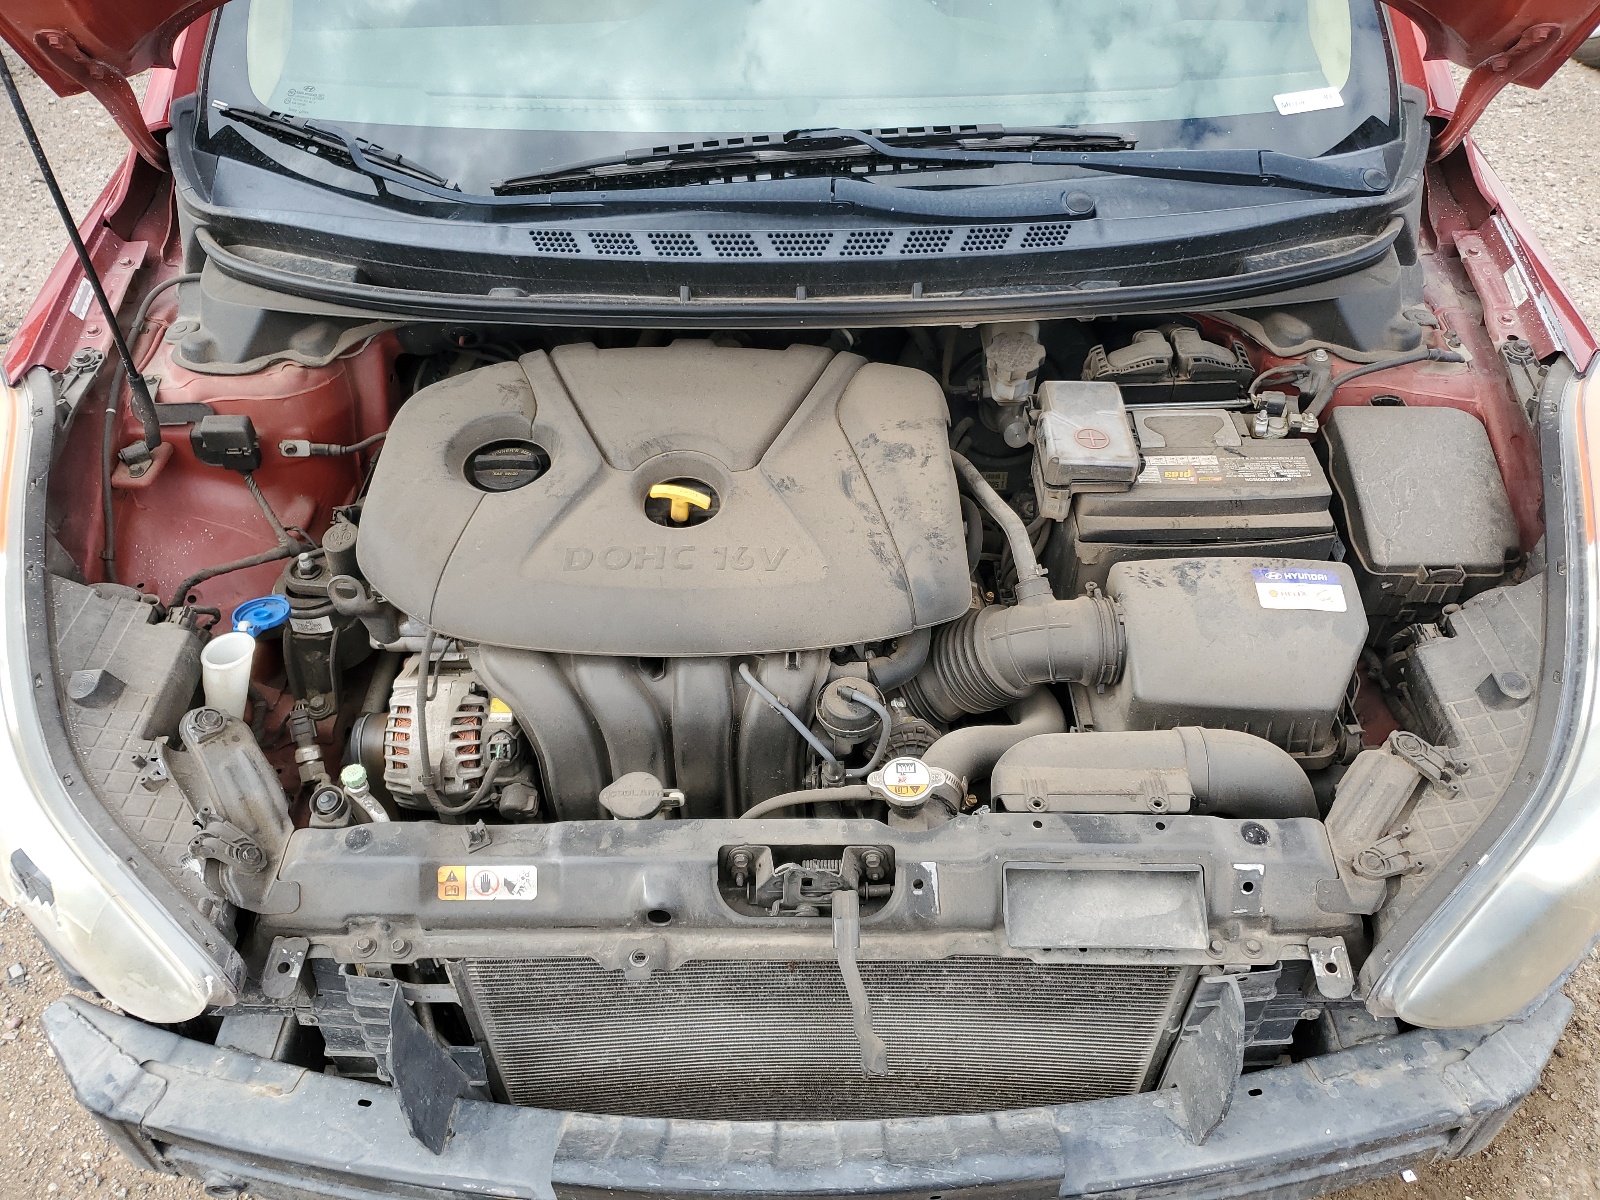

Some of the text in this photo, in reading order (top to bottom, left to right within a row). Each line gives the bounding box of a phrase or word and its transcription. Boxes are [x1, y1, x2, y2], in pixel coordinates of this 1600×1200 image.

[562, 545, 789, 571] DOHC 16V
[1284, 572, 1328, 581] HYUNDAI
